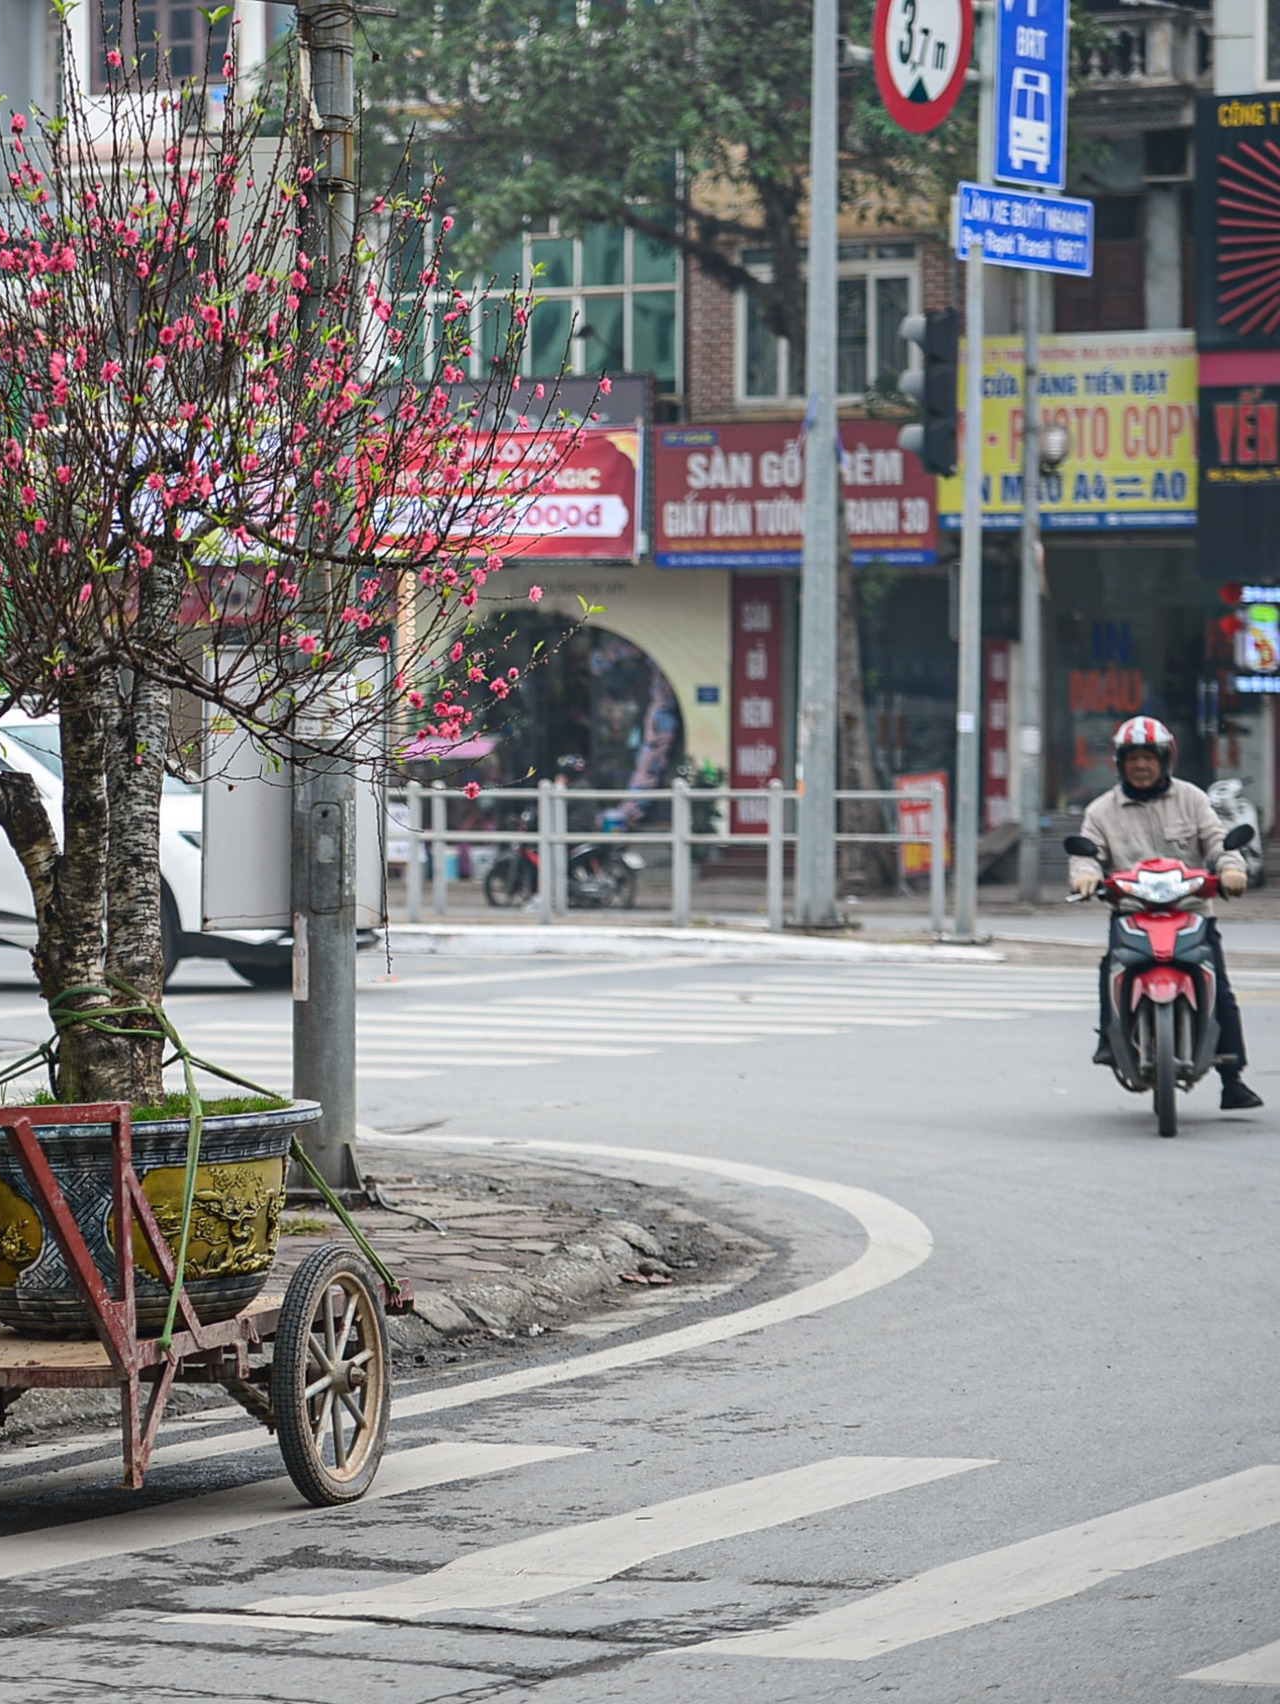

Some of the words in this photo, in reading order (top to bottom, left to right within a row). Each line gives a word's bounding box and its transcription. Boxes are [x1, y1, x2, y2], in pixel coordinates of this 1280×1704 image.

[1016, 24, 1048, 60] BRT
[1218, 99, 1266, 127] CÔNG
[1009, 404, 1111, 463] POTO
[686, 444, 752, 488] SÀN
[755, 490, 805, 535] TƯỜN
[901, 496, 930, 535] 3D
